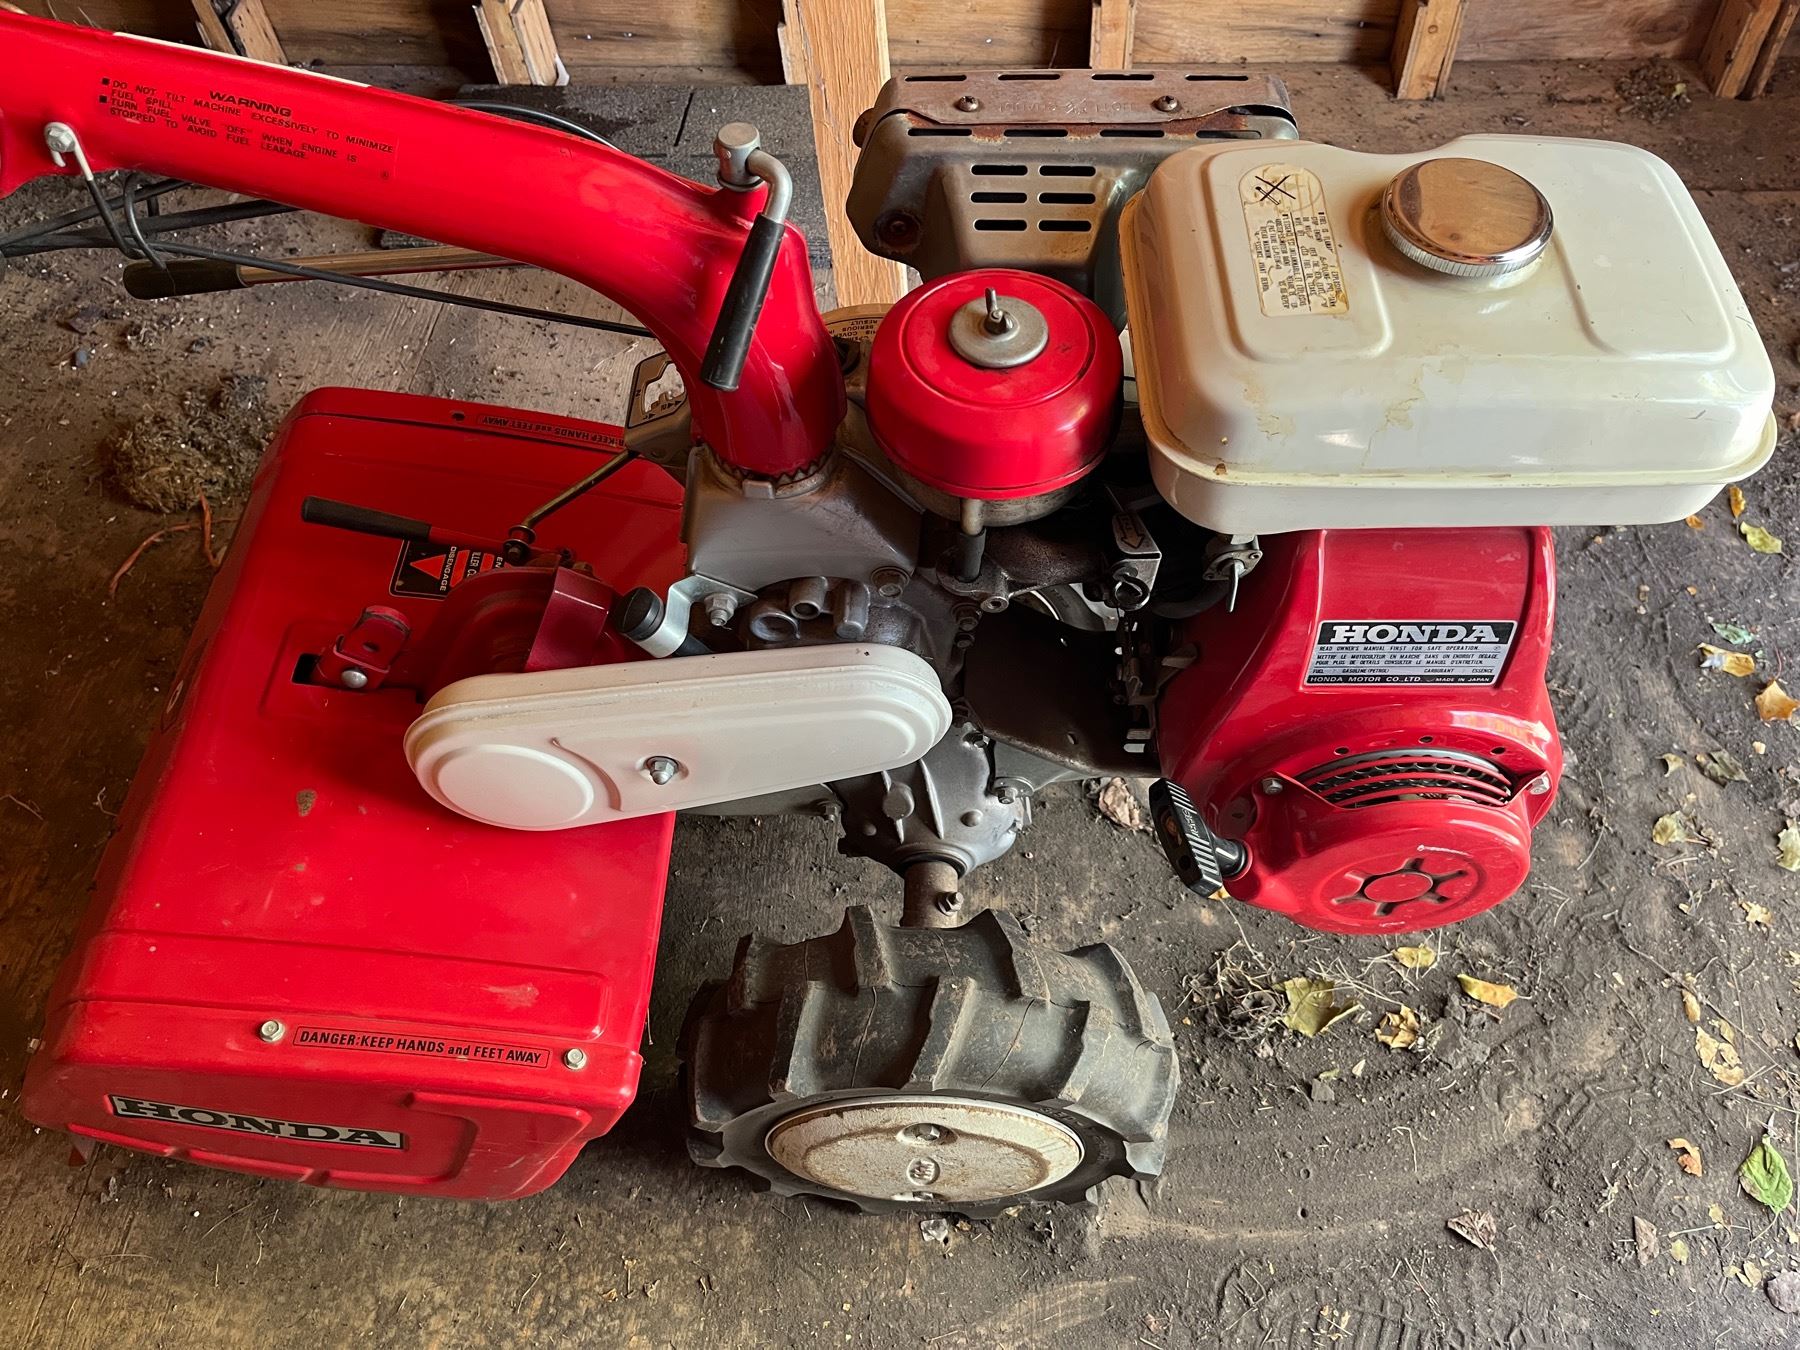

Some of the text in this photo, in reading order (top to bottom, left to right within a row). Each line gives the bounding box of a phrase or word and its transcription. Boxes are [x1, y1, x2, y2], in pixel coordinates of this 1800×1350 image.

[112, 89, 173, 109] FUEL SPILL
[210, 91, 291, 116] WARNING
[110, 107, 155, 123] STOPPED
[166, 120, 178, 128] TO
[187, 125, 217, 137] AVOID
[226, 134, 248, 145] FUEL
[111, 98, 137, 110] TURN
[147, 108, 170, 118] FUEL
[182, 114, 211, 127] VALVE
[263, 133, 292, 147] WHEN
[302, 143, 336, 158] ENGINE
[348, 154, 357, 162] IS
[113, 80, 393, 153] DO NOT TILT MACHINE EXCESSIVELY TO MINIMIZE
[483, 416, 509, 428] AWAY
[439, 546, 457, 591] DISENGAGE
[1330, 625, 1499, 643] HONDA
[396, 1038, 444, 1053] HANDS
[448, 1045, 469, 1056] and
[473, 1046, 502, 1059] FEET
[506, 1050, 541, 1064] AWAY
[117, 1097, 396, 1146] HONDA
